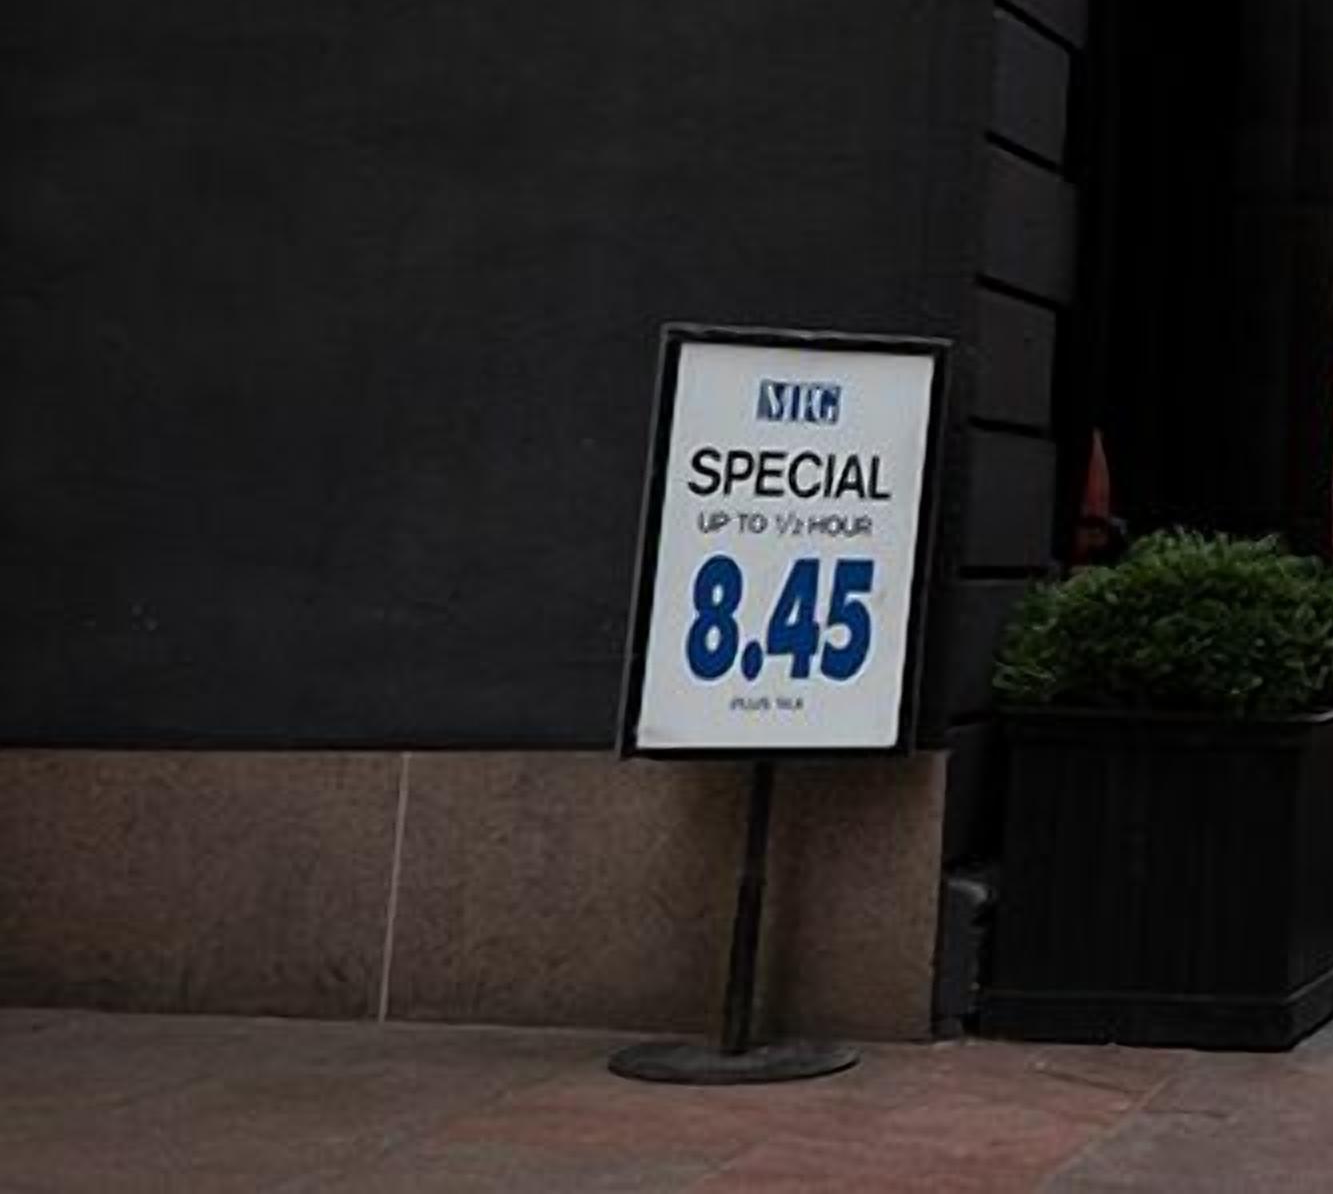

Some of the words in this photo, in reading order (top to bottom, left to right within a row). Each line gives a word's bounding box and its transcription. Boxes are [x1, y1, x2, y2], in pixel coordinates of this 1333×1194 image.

[687, 447, 891, 501] SPECIAL
[697, 511, 731, 534] UP
[736, 512, 768, 535] TO
[807, 513, 873, 537] HOUR
[686, 554, 875, 682] 8.45
